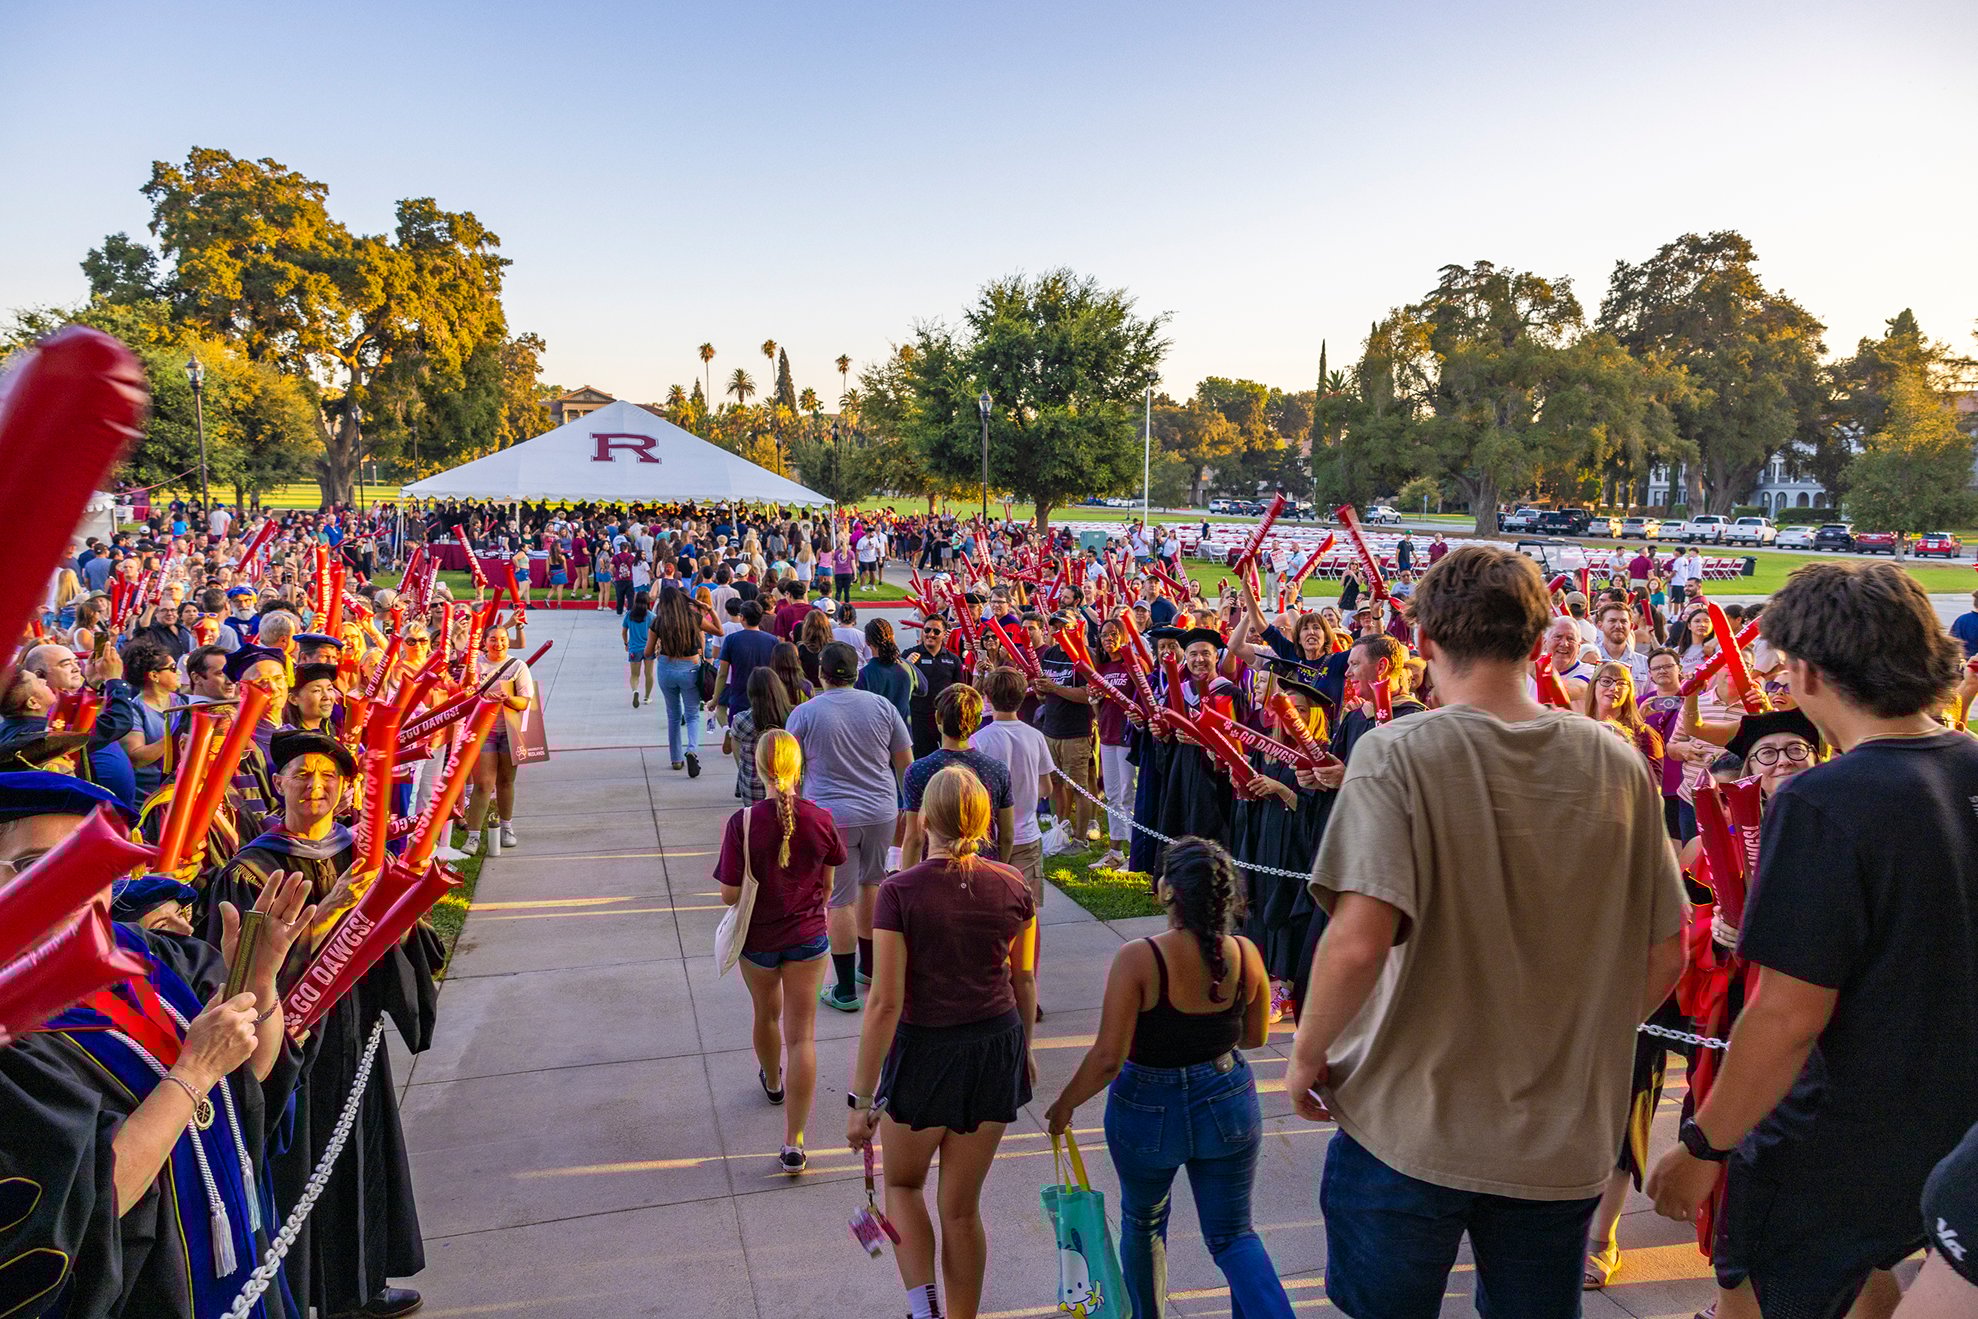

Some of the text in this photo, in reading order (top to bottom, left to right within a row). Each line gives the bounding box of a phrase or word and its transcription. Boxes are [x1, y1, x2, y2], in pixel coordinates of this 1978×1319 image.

[590, 432, 662, 464] R
[366, 684, 376, 696] GO
[1110, 678, 1128, 686] ANDS
[1146, 694, 1156, 706] GO
[406, 706, 460, 740] GO DAWGS!
[1238, 732, 1299, 766] GO DAWGS!
[1293, 719, 1326, 762] GO DAWGS!
[358, 774, 378, 857] GO DAWGS!
[411, 754, 460, 844] GO DAWGS!
[1742, 825, 1759, 876] AWGS!
[290, 910, 376, 1013] GO DAWGS!
